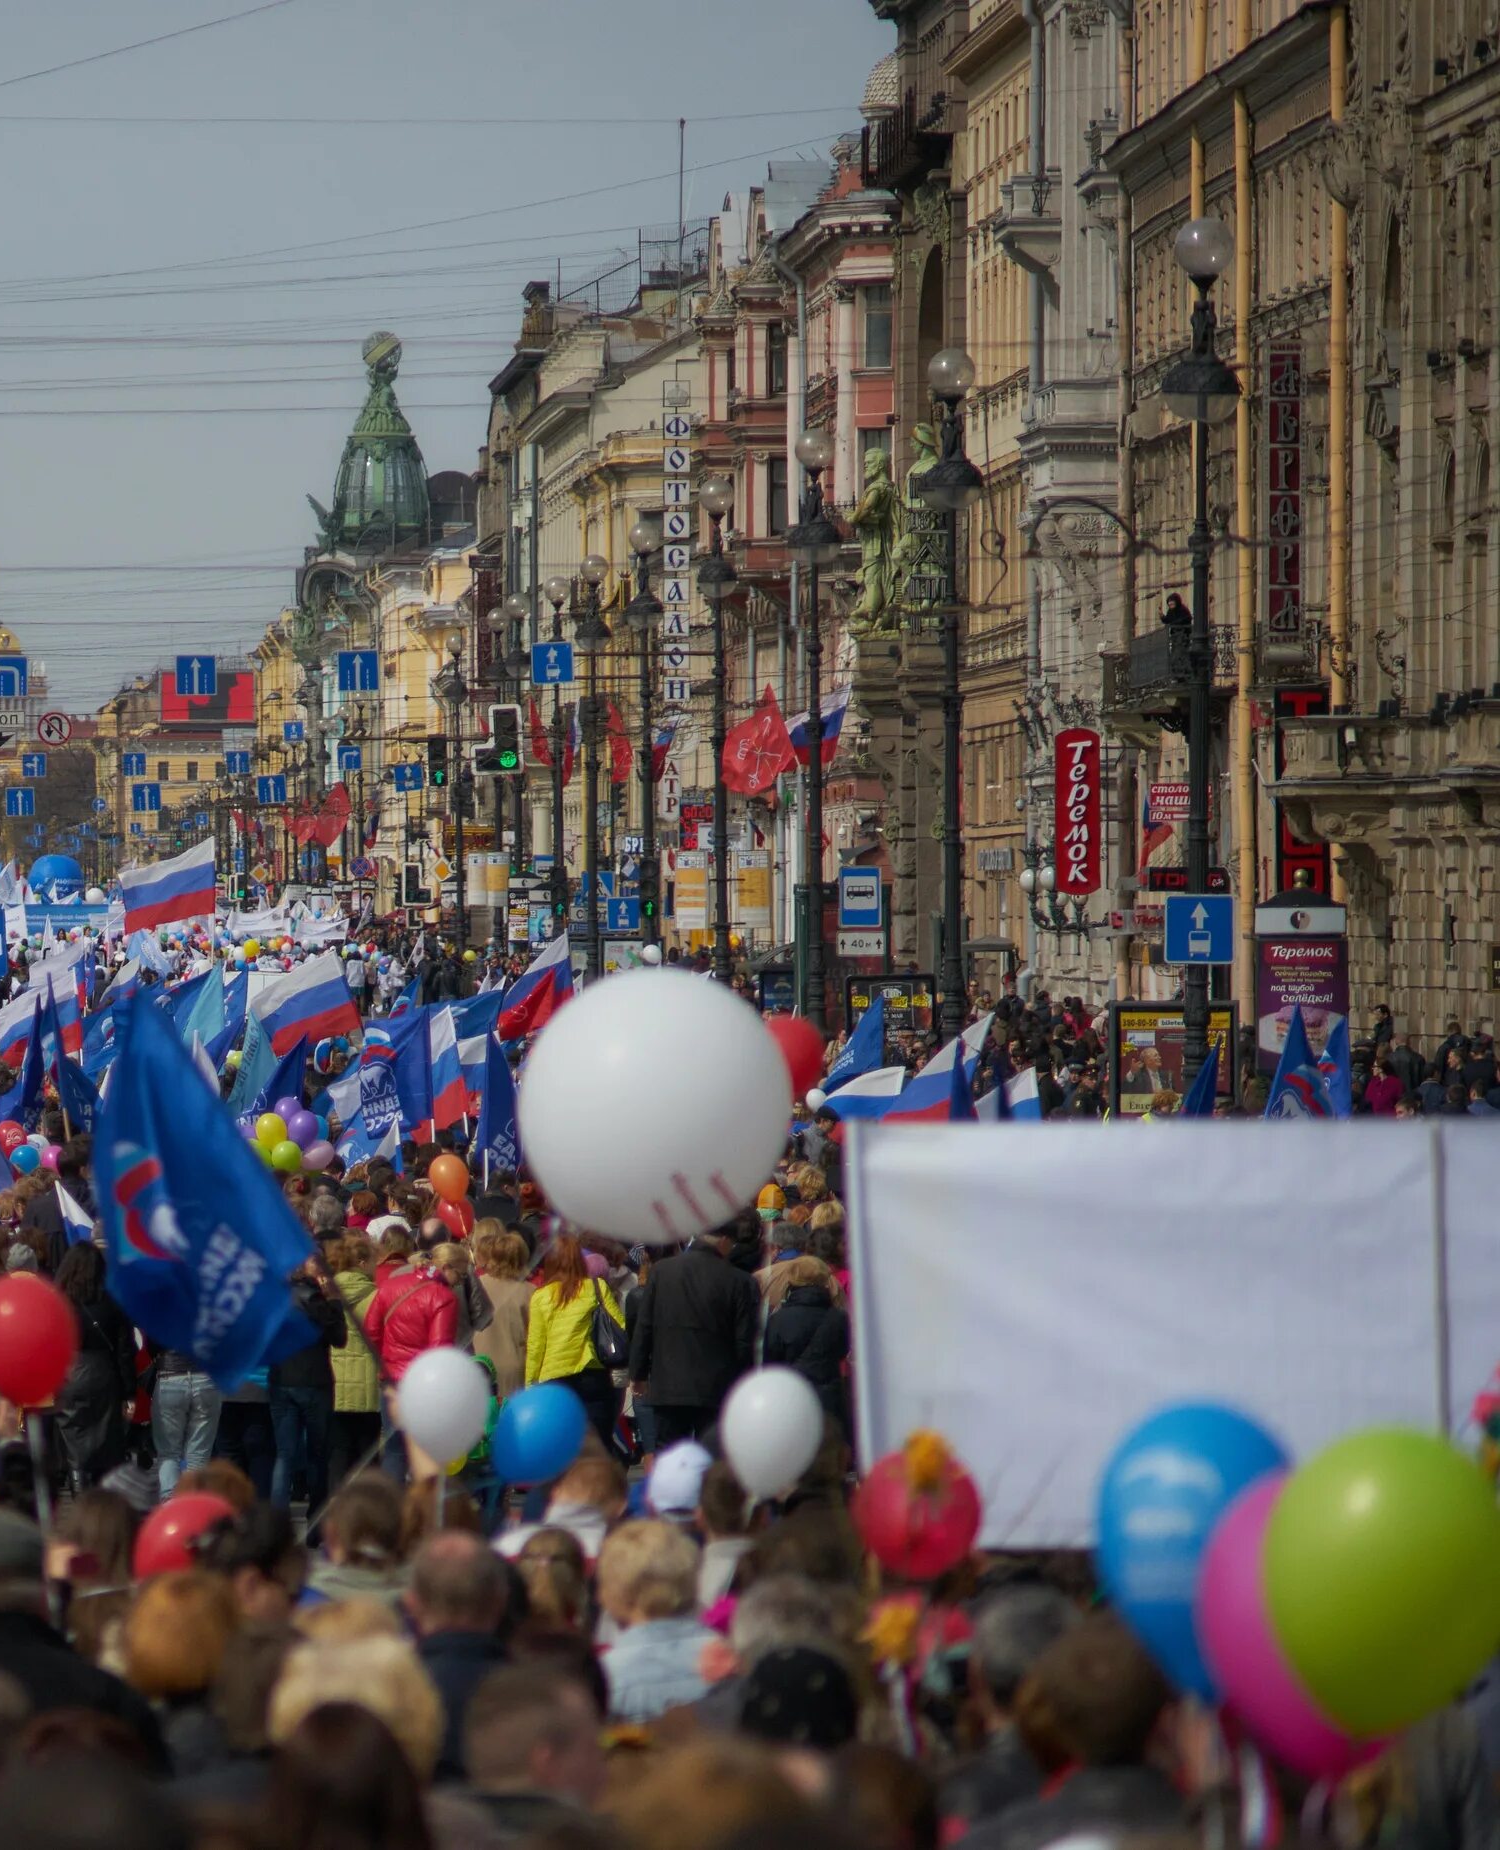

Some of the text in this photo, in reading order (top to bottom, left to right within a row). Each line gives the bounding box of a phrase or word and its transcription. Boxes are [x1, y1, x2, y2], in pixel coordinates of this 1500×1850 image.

[666, 416, 690, 700] ФОТОСАЛОН
[1271, 355, 1299, 631] АВРОРА
[1064, 740, 1093, 883] Теремок
[1270, 945, 1333, 960] Теремок
